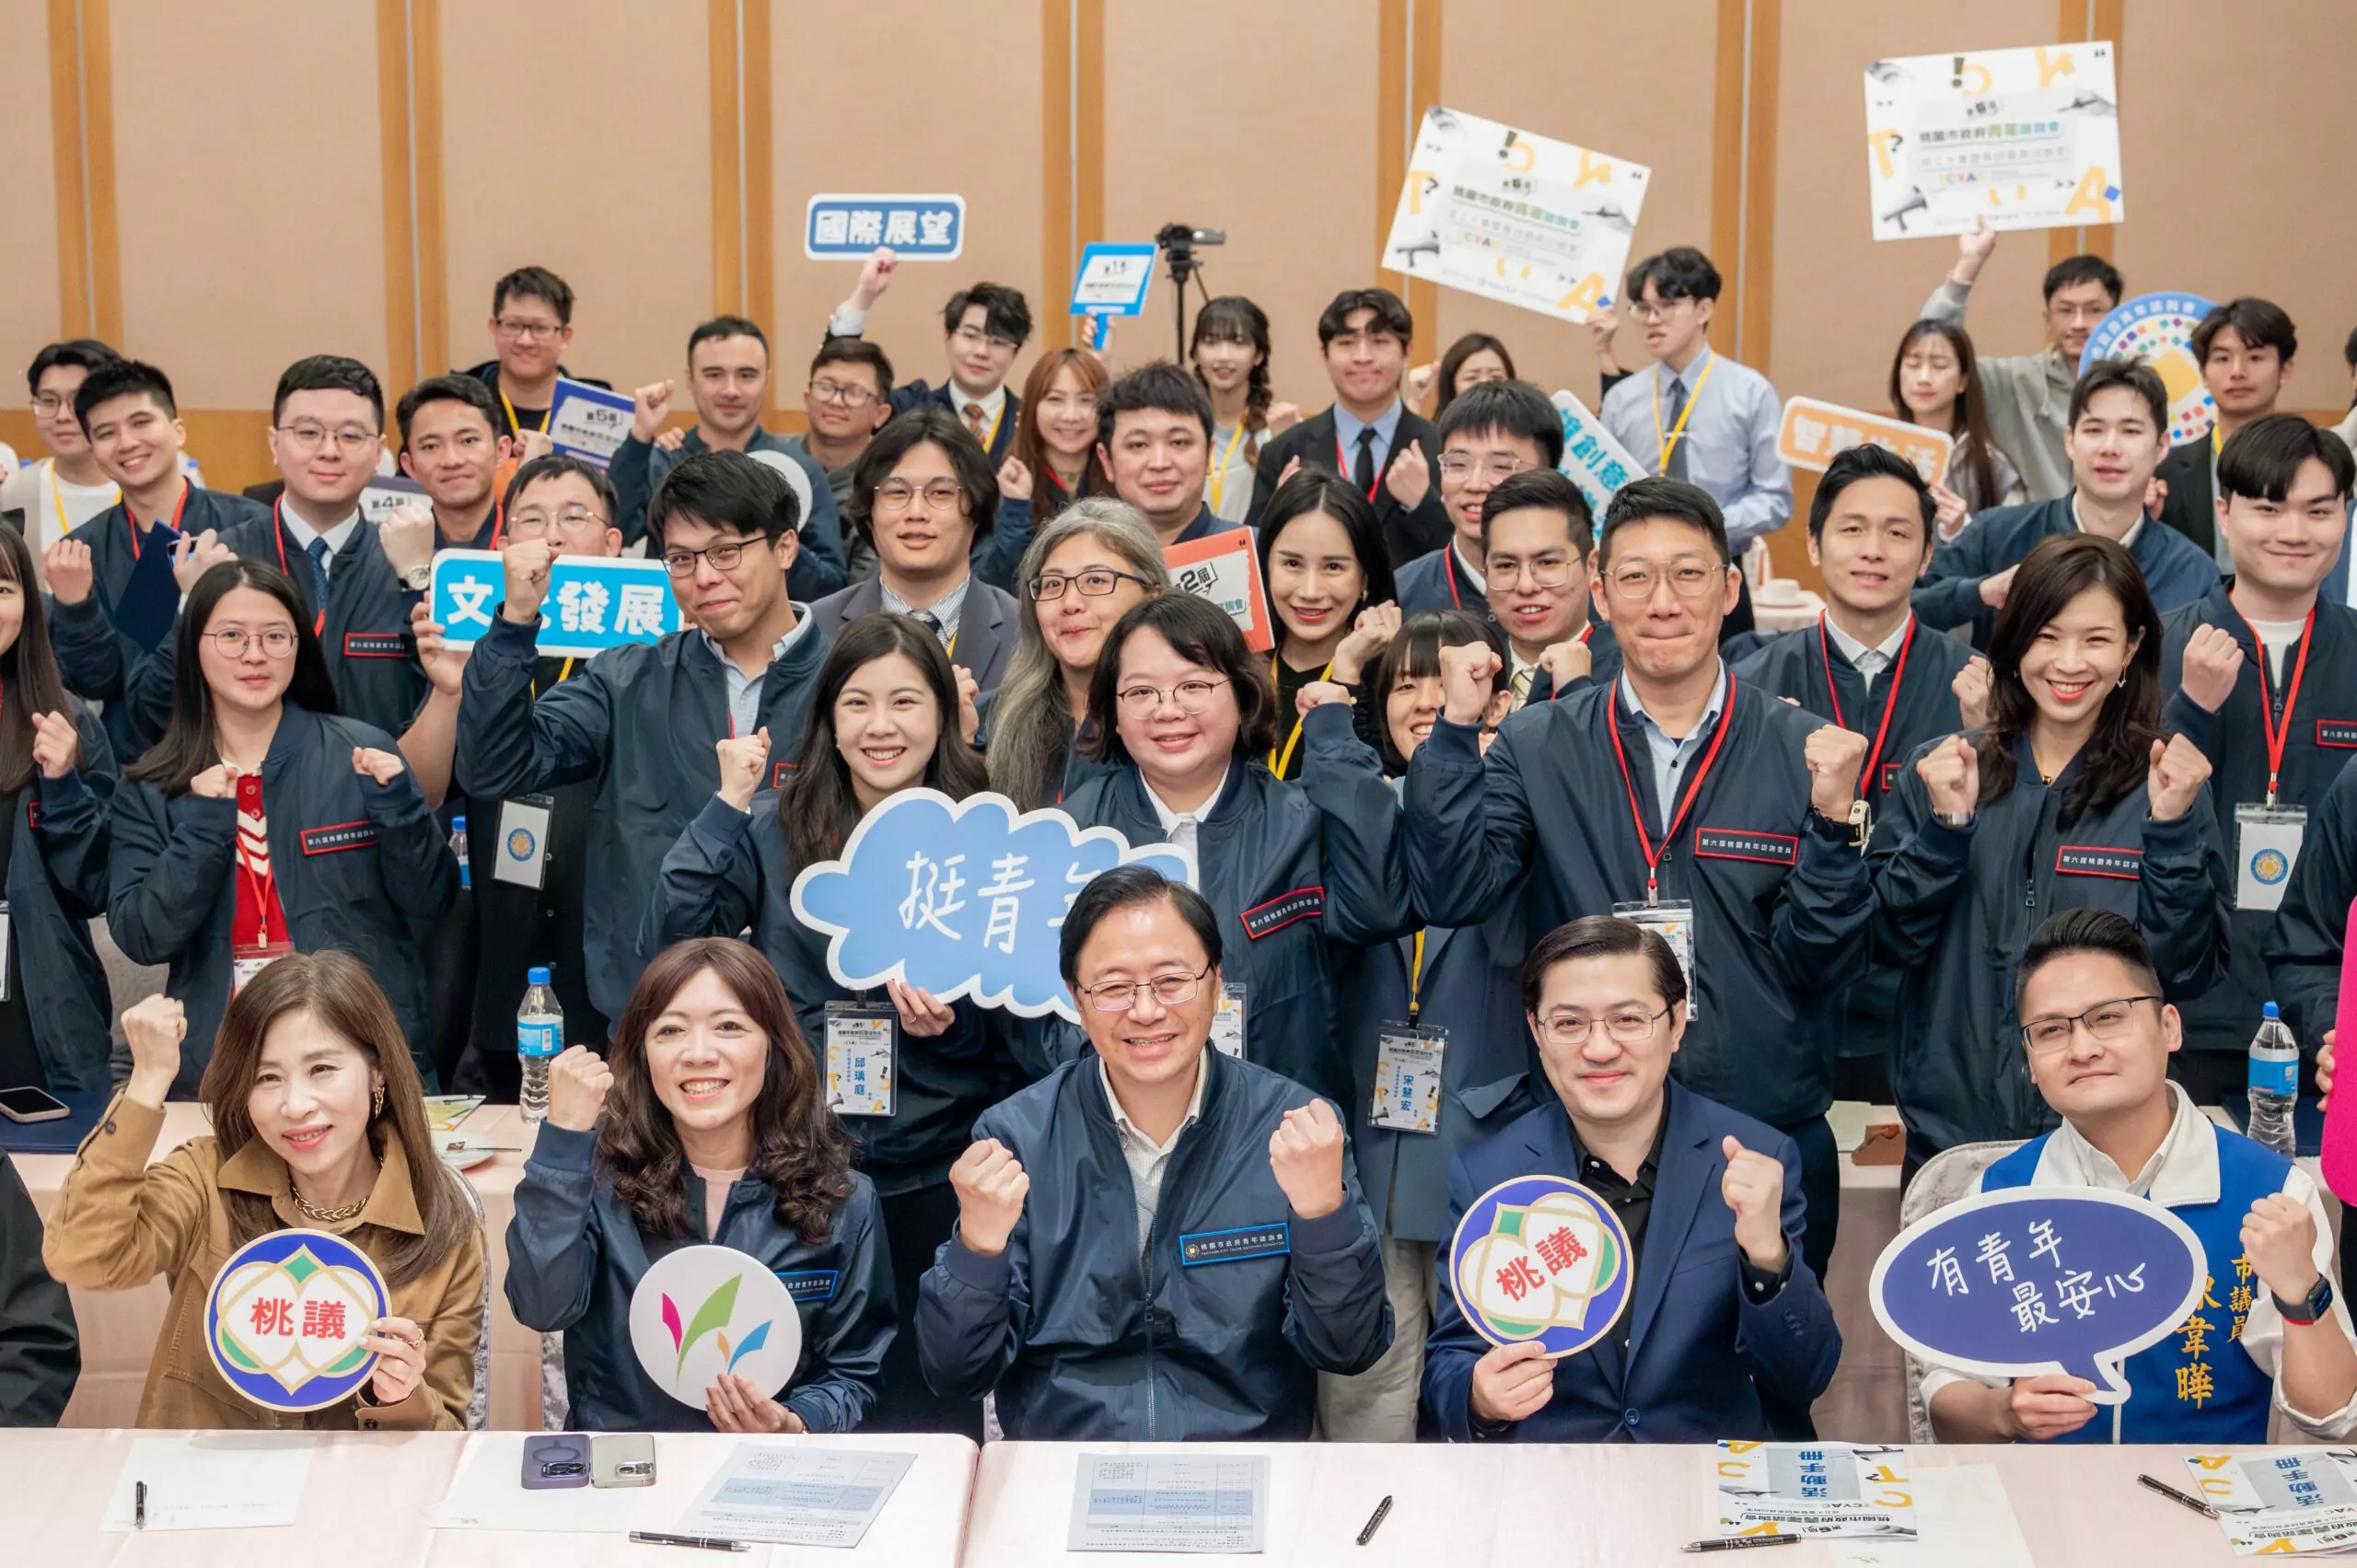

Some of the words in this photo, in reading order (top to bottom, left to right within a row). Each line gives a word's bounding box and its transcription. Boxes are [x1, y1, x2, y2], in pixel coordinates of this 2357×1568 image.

[815, 209, 954, 246] 國際展望
[446, 575, 666, 637] 文發展
[1701, 837, 1792, 854] 第六屆桃園青年諮詢委員
[1249, 897, 1321, 929] 第六屆桃園青年諮詢委員
[1200, 1233, 1283, 1251] 桃園市政府青年諮詢會
[1496, 1225, 1589, 1303] 桃議
[1926, 1218, 2064, 1296] 有青年
[783, 1278, 831, 1290] 政府青年諮詢會
[2010, 1261, 2147, 1333] 最安心
[2227, 1252, 2254, 1343] 市議員
[250, 1296, 346, 1341] 桃議
[1798, 1450, 1827, 1498] 活動手冊
[2275, 1457, 2326, 1507] 活動手冊
